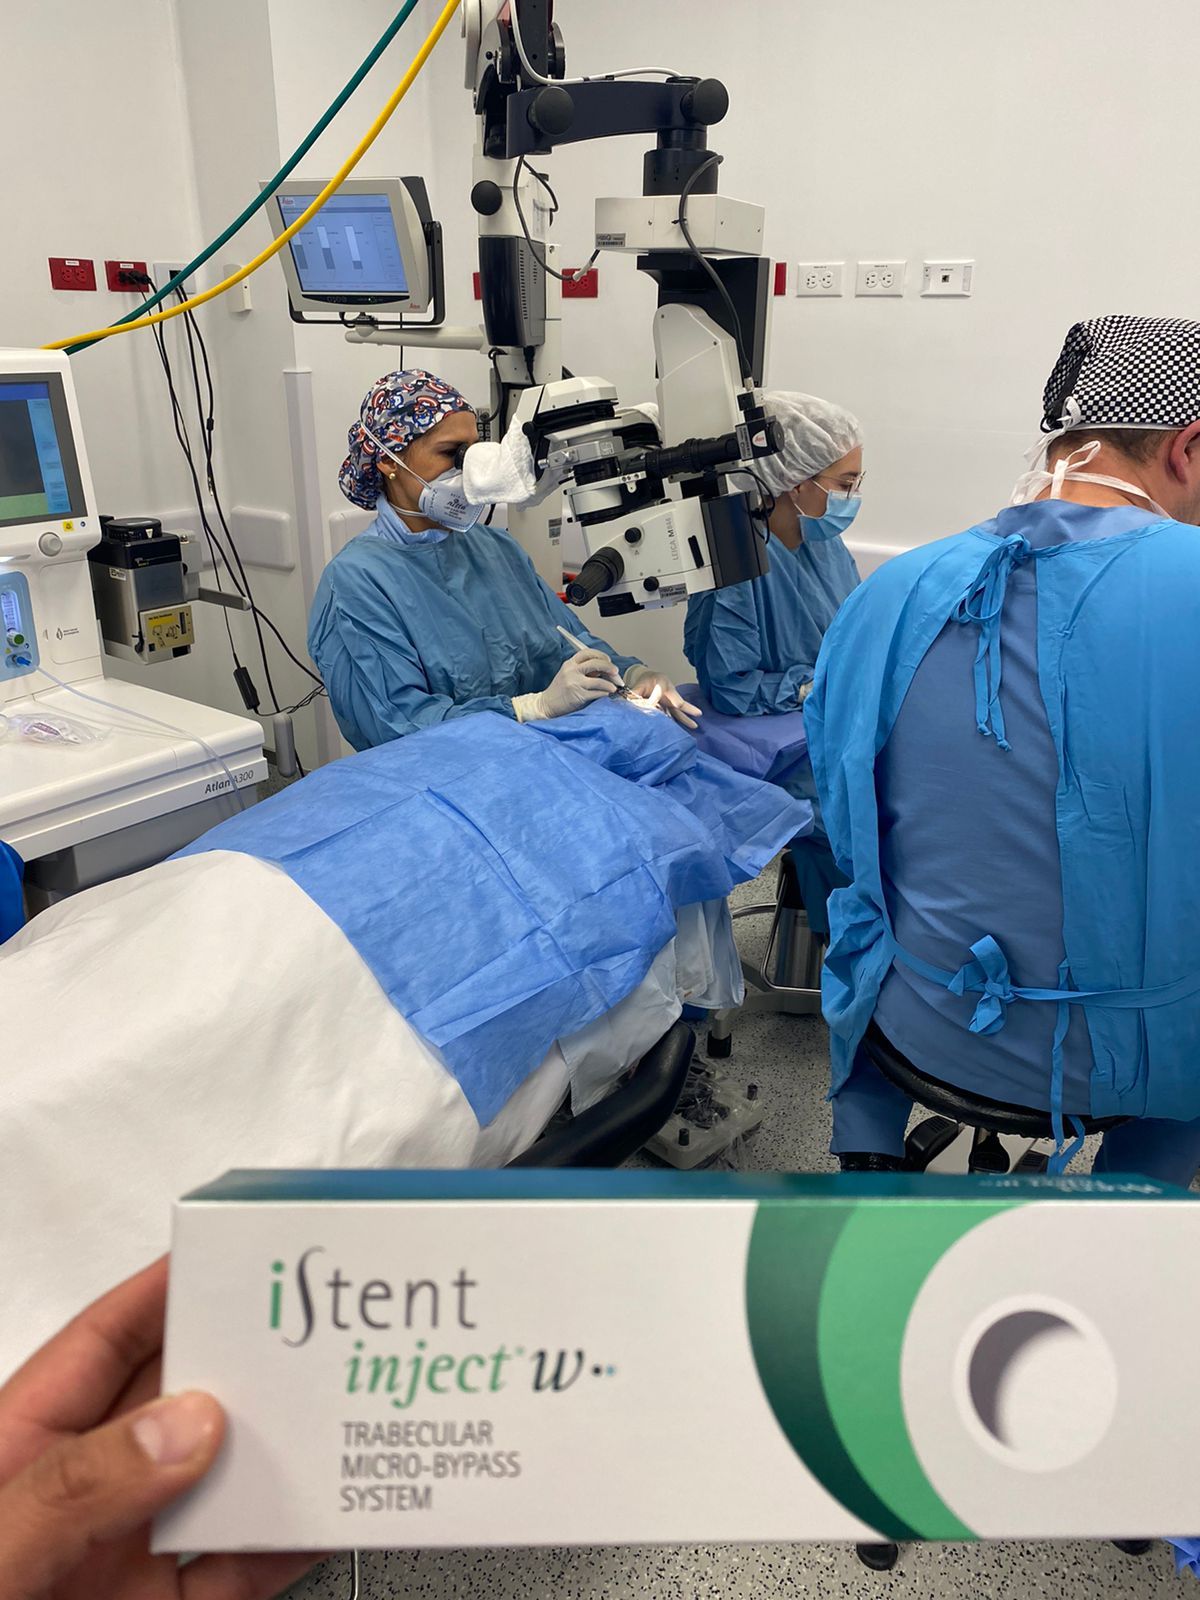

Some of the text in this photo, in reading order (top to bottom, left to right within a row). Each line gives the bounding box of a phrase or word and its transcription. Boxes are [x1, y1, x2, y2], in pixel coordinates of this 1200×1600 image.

[205, 779, 231, 794] Atlan
[269, 1246, 478, 1349] iStent
[341, 1419, 494, 1448] TRABECULAR
[340, 1450, 522, 1480] MICRO-BYPASS
[339, 1484, 433, 1513] SYSTEM
